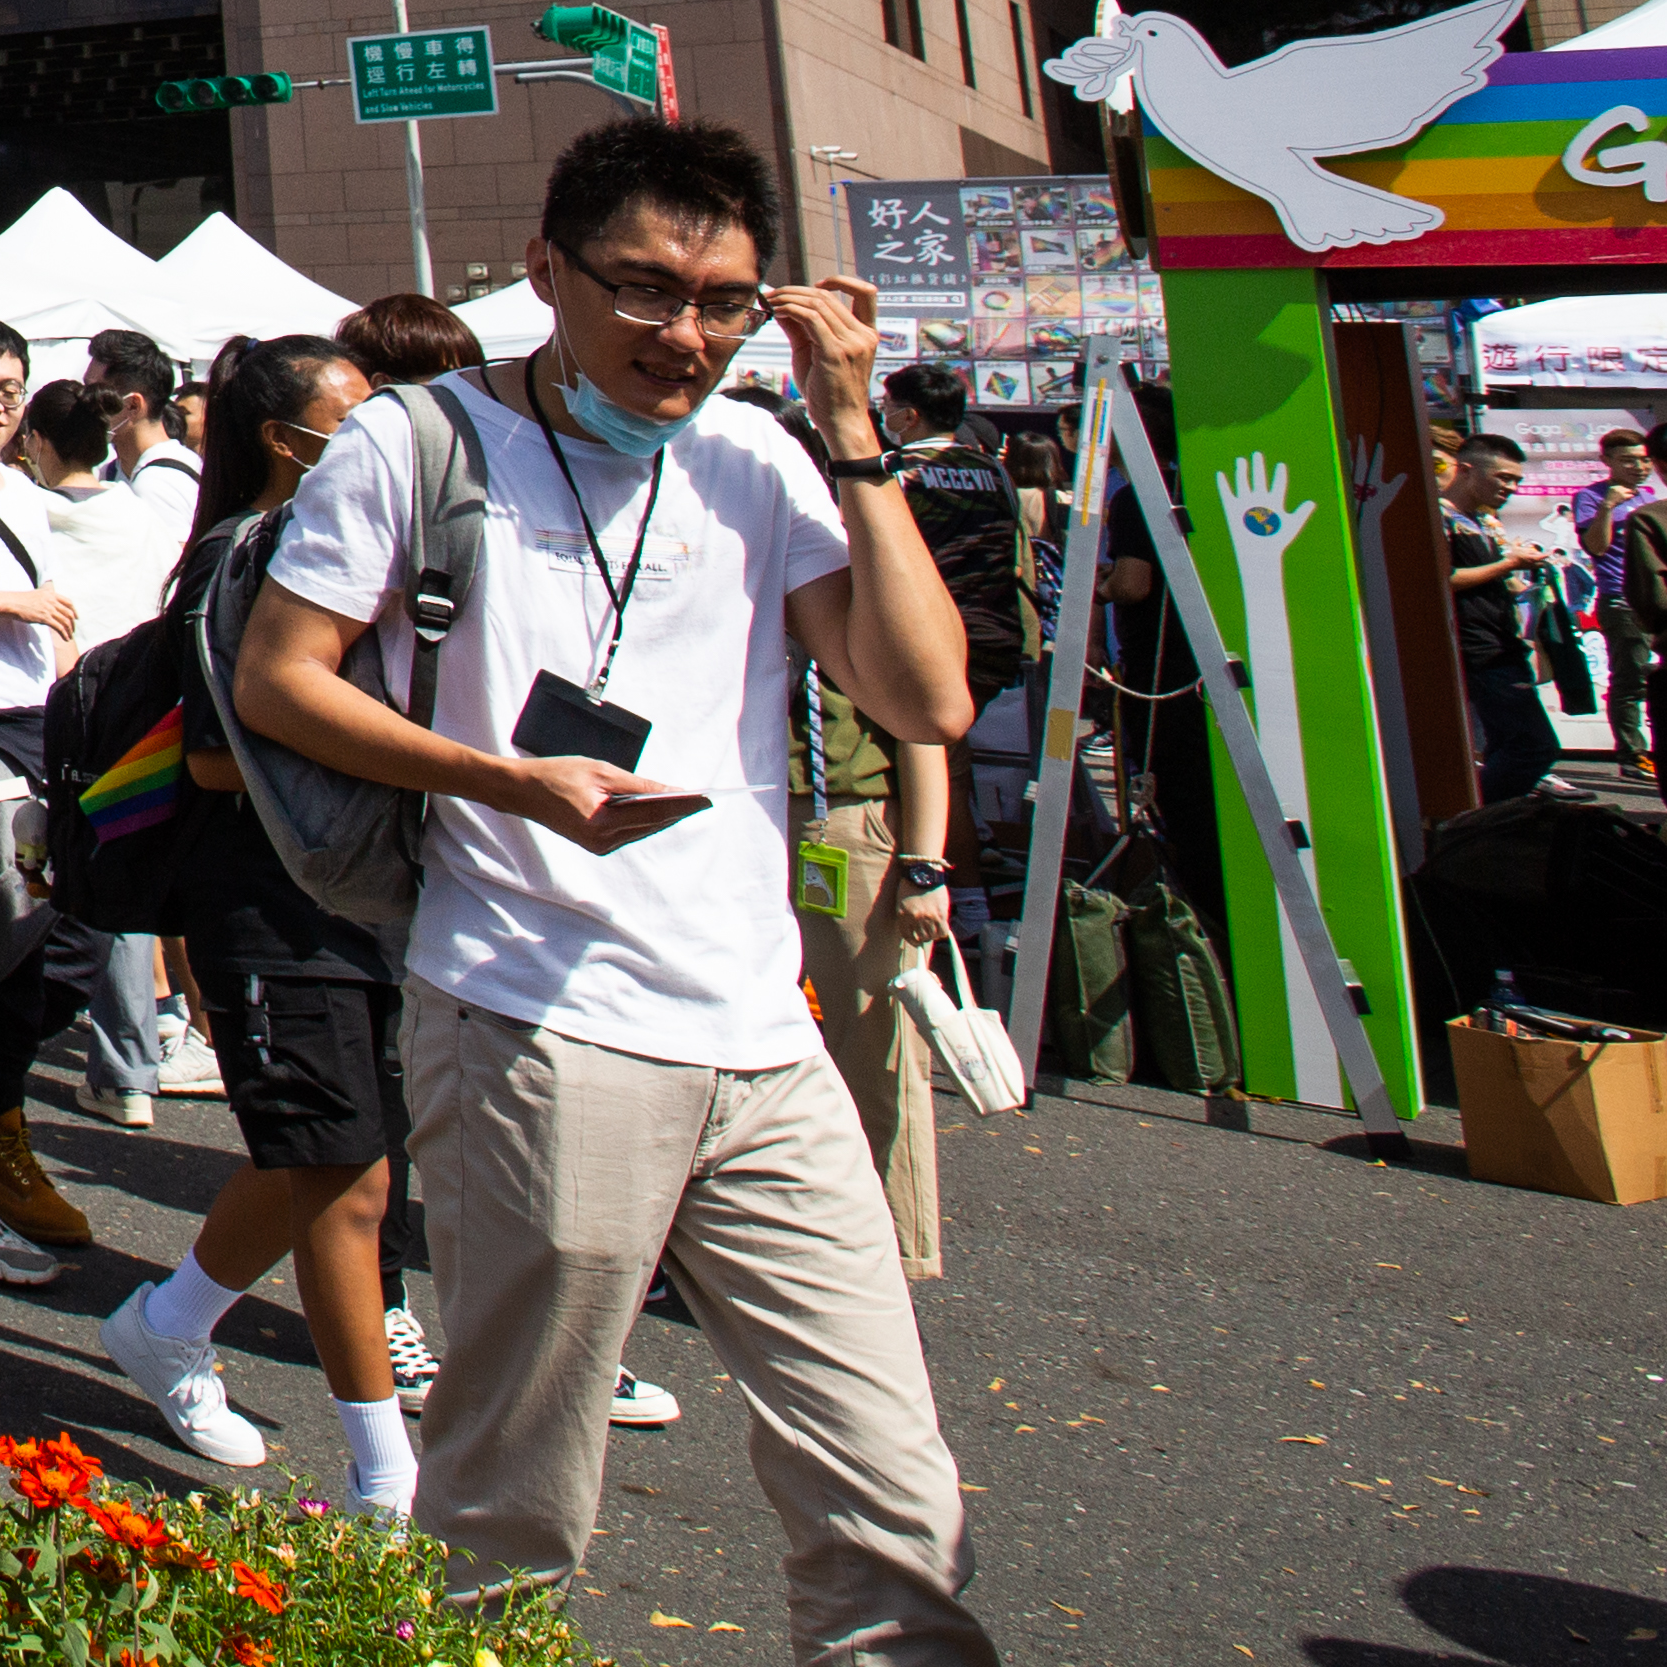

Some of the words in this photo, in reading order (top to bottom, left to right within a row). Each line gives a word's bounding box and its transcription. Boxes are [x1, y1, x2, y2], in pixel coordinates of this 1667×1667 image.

[364, 36, 475, 63] 機慢車得
[363, 87, 379, 99] Left
[380, 87, 398, 97] Turn
[399, 85, 423, 95] Ahead
[424, 83, 436, 93] for
[437, 81, 485, 93] Motorcycles
[364, 105, 379, 114] and
[381, 103, 399, 113] Slow
[400, 101, 433, 112] Vehicles
[868, 198, 951, 230] 好人
[873, 229, 955, 266] 之家
[1482, 342, 1667, 374] 遊行限定
[918, 466, 997, 492] MCCCVII
